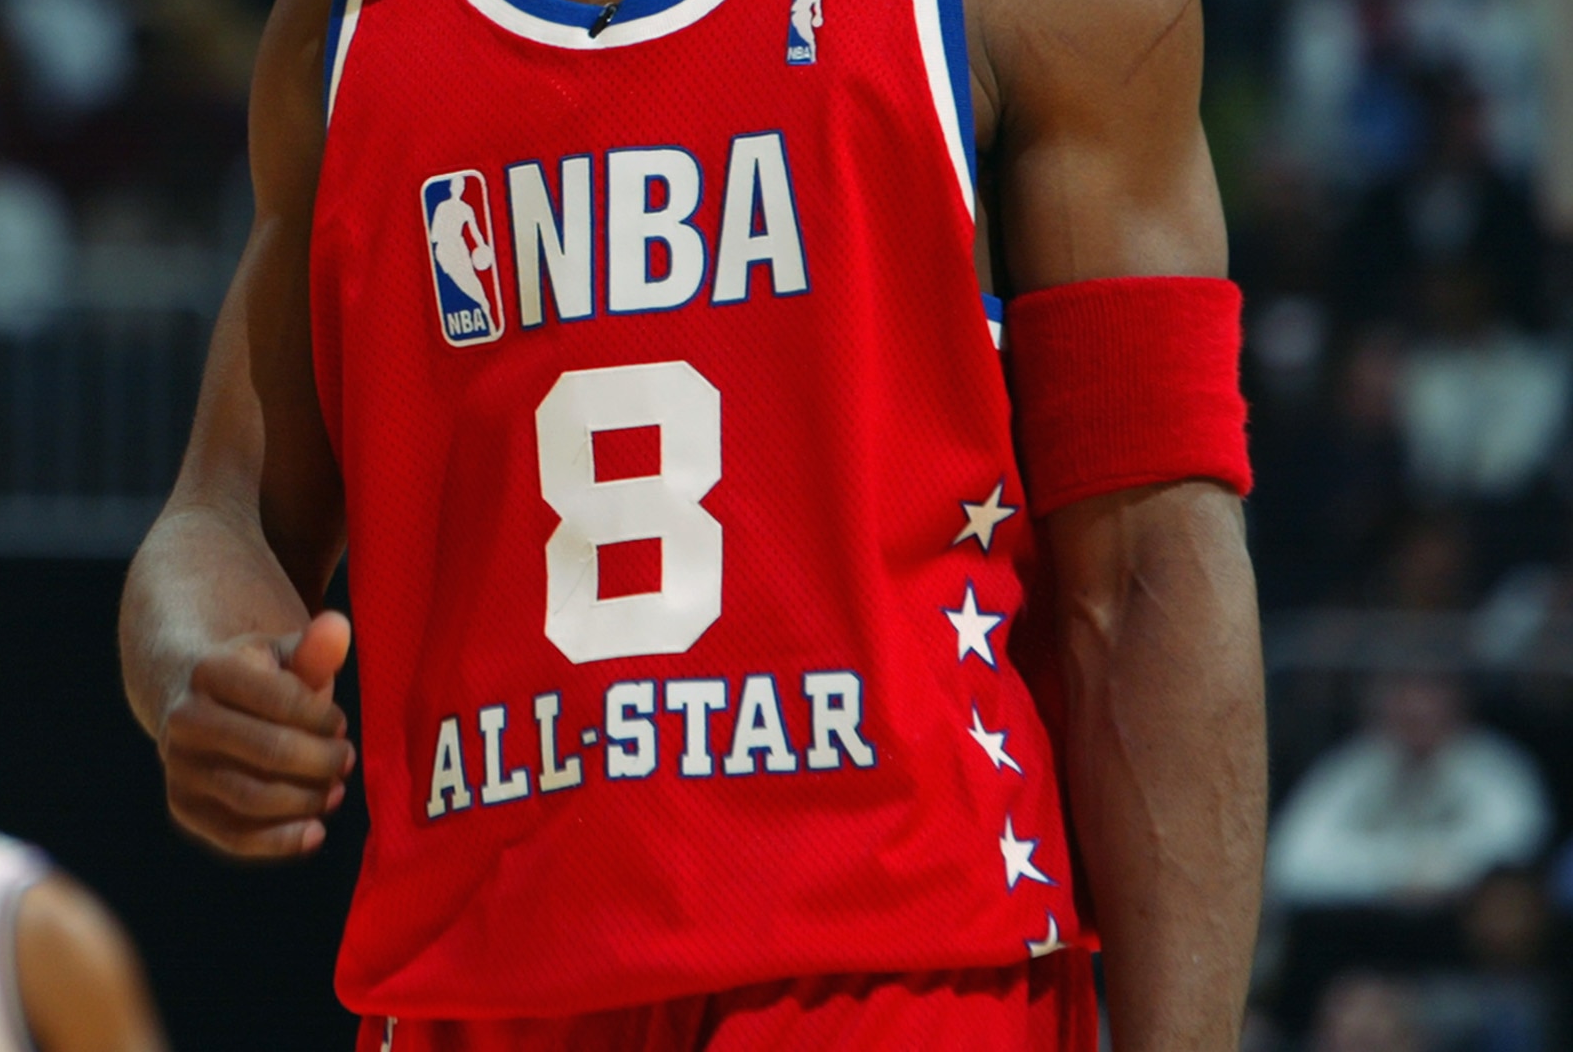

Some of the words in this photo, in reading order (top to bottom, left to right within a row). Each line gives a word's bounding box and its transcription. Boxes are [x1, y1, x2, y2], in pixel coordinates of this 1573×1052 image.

[505, 129, 811, 330] NBA
[447, 307, 487, 337] NBA
[534, 359, 724, 666] 8
[426, 669, 876, 819] ALL-STAR
